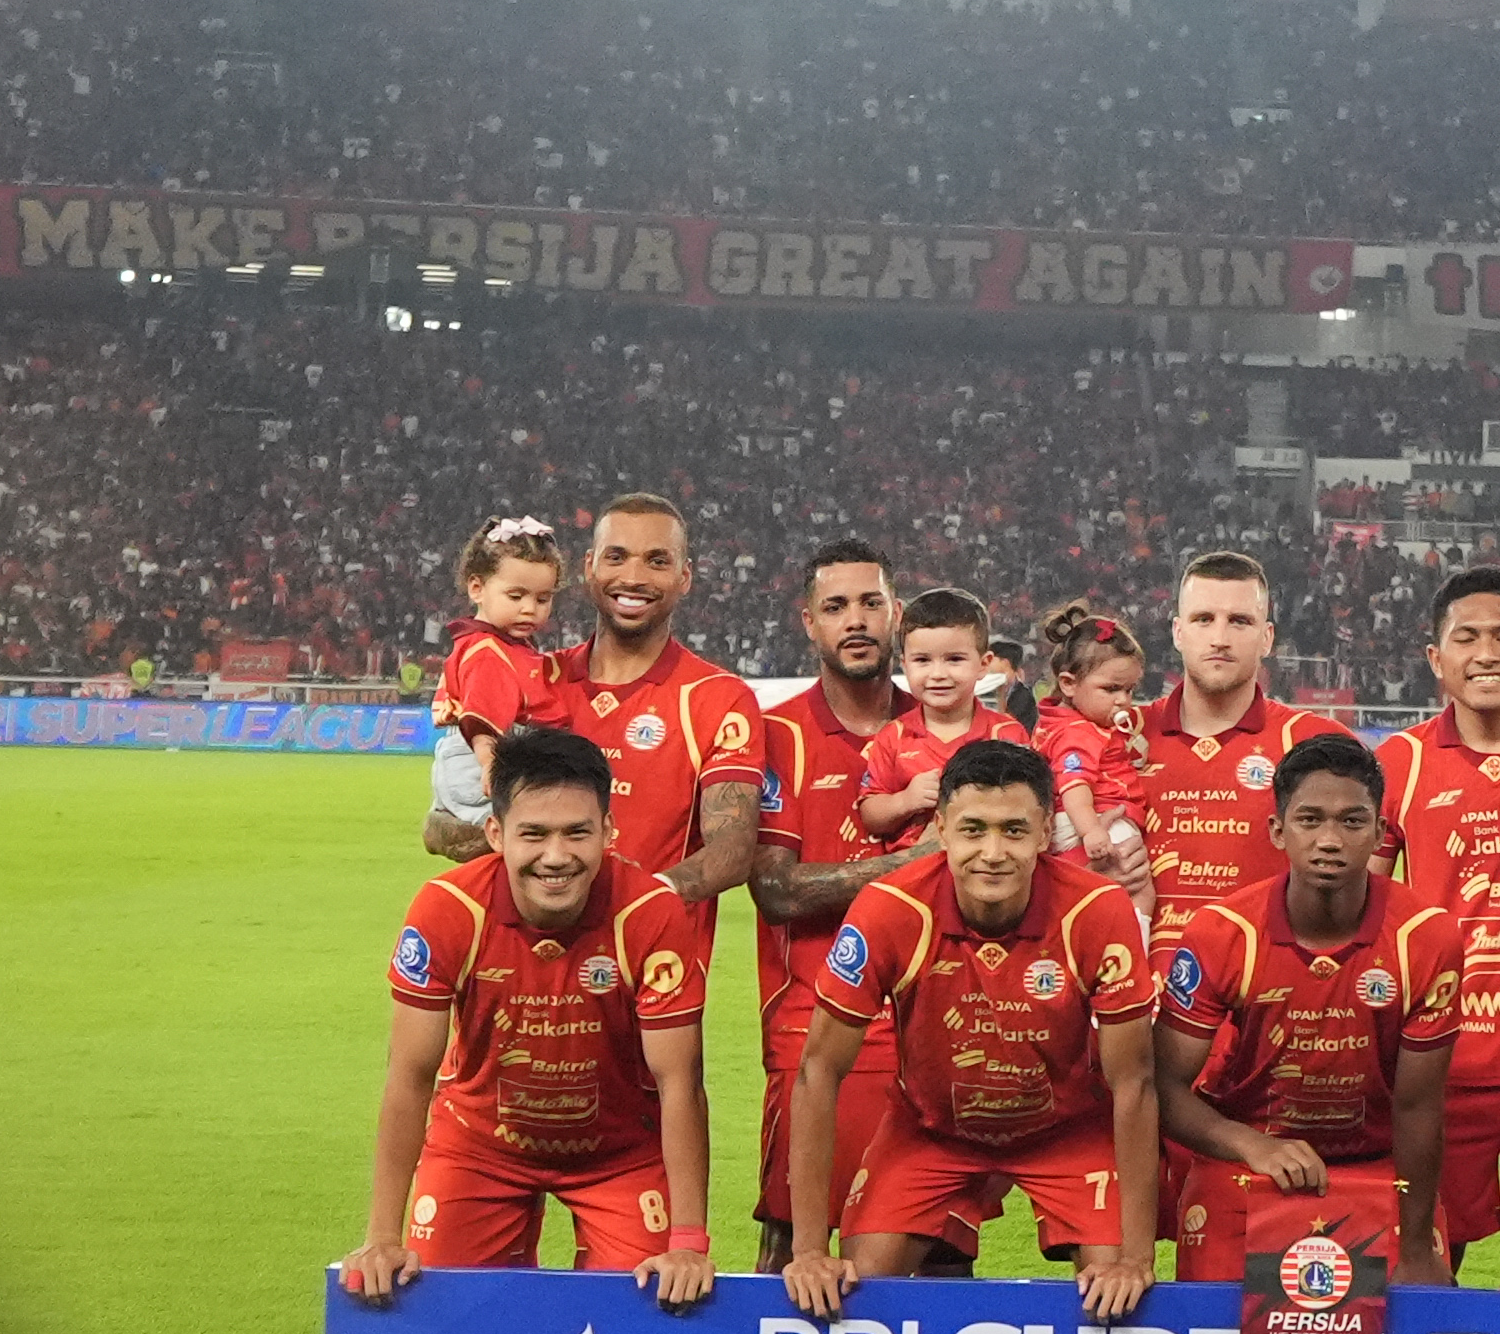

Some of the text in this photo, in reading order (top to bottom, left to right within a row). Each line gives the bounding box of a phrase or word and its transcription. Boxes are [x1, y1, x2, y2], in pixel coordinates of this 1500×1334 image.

[18, 195, 287, 269] MAKE
[708, 229, 991, 300] GREAT
[1016, 241, 1286, 307] AGAIN
[1169, 790, 1238, 801] PAM JAYA
[1173, 806, 1199, 815] Bank
[1467, 810, 1498, 823] PAM
[1167, 817, 1250, 835] Jakarta
[1473, 826, 1499, 836] Bank
[1179, 861, 1239, 877] Bakrie
[515, 994, 584, 1007] PAM JAYA
[995, 999, 1033, 1014] JAYA
[1292, 1007, 1356, 1022] PAM JAYA
[516, 1019, 601, 1038] Jakarta
[1287, 1034, 1369, 1052] Jakarta
[531, 1057, 598, 1073] Bakrie
[1302, 1072, 1365, 1087] Bakrie
[638, 1189, 669, 1234] 8
[410, 1224, 435, 1240] TCT
[1181, 1233, 1207, 1247] TCT
[1296, 1244, 1337, 1253] PERSIJA
[1266, 1311, 1363, 1332] PERSIJA
